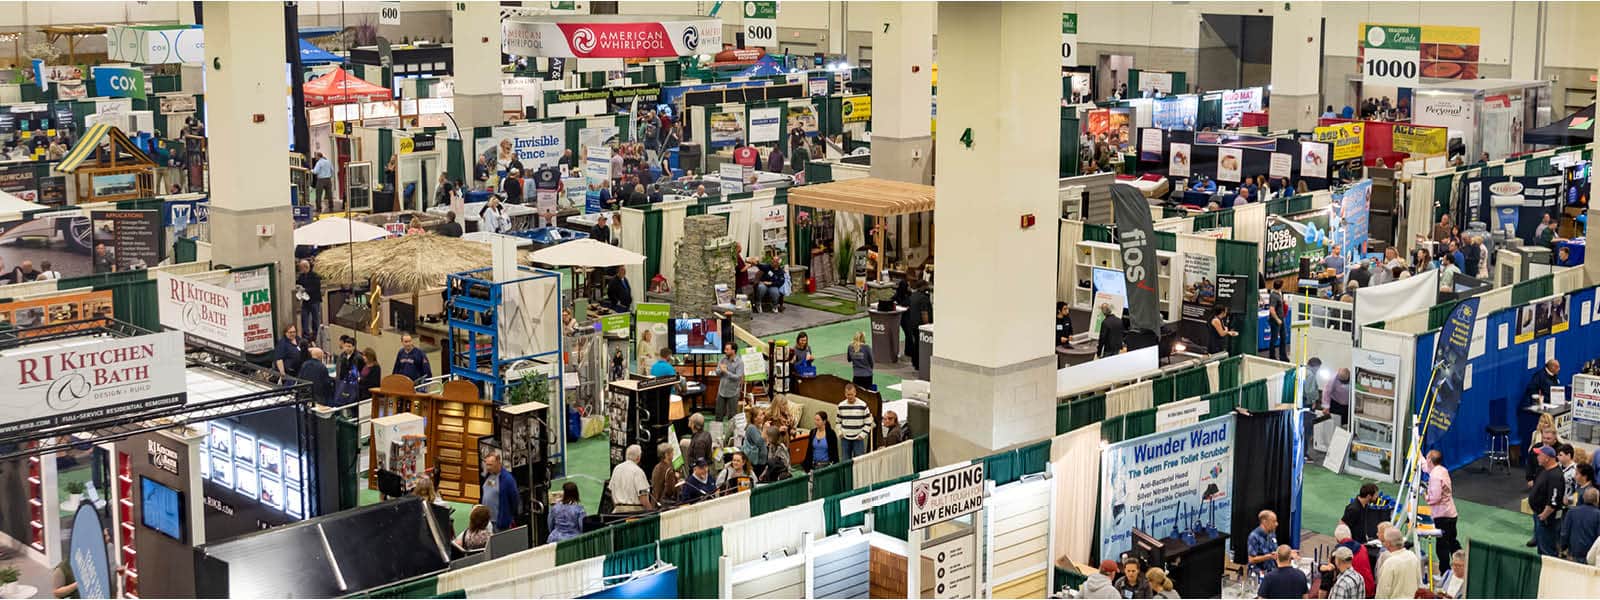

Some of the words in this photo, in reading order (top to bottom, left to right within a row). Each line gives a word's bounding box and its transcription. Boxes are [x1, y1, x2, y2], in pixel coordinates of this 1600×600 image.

[382, 8, 398, 19] 600
[508, 31, 542, 40] MERICAN
[600, 32, 663, 40] AMERICAN
[748, 25, 772, 40] 800
[883, 23, 890, 33] 7
[600, 40, 664, 50] WHIRLPOOL
[214, 57, 221, 70] 6
[1366, 59, 1417, 79] 1000
[110, 76, 136, 91] COX
[1426, 106, 1462, 116] Personal
[514, 136, 560, 148] Invisible
[960, 128, 973, 148] 4
[514, 149, 545, 160] Fence
[1267, 235, 1296, 252] nozzle
[1268, 229, 1290, 242] hose
[1120, 228, 1147, 284] fios
[170, 278, 185, 302] RI
[187, 282, 230, 310] KITCHEN
[242, 288, 269, 306] WIN
[202, 304, 227, 326] BATH
[60, 344, 154, 372] KITCHEN
[18, 354, 55, 386] RI
[92, 365, 150, 386] BATH
[94, 390, 121, 400] DESIGN
[106, 403, 144, 414] RESIDENTIAL
[1134, 438, 1186, 464] Wunder
[1190, 423, 1226, 449] Wand
[1129, 469, 1141, 480] The
[1144, 464, 1162, 476] Germ
[1164, 460, 1179, 471] Free
[1180, 454, 1199, 465] Toilet
[1200, 446, 1230, 459] Scrubber
[931, 466, 982, 497] SIDING
[1140, 475, 1174, 489] Anti-Bacterial
[1137, 492, 1152, 500] Silver
[1153, 487, 1169, 495] Nitrate
[1170, 480, 1189, 490] Infused
[1154, 496, 1173, 504] Flexible
[1174, 488, 1197, 498] Cleaning
[913, 510, 936, 526] NEW
[938, 496, 982, 518] ENGLAND
